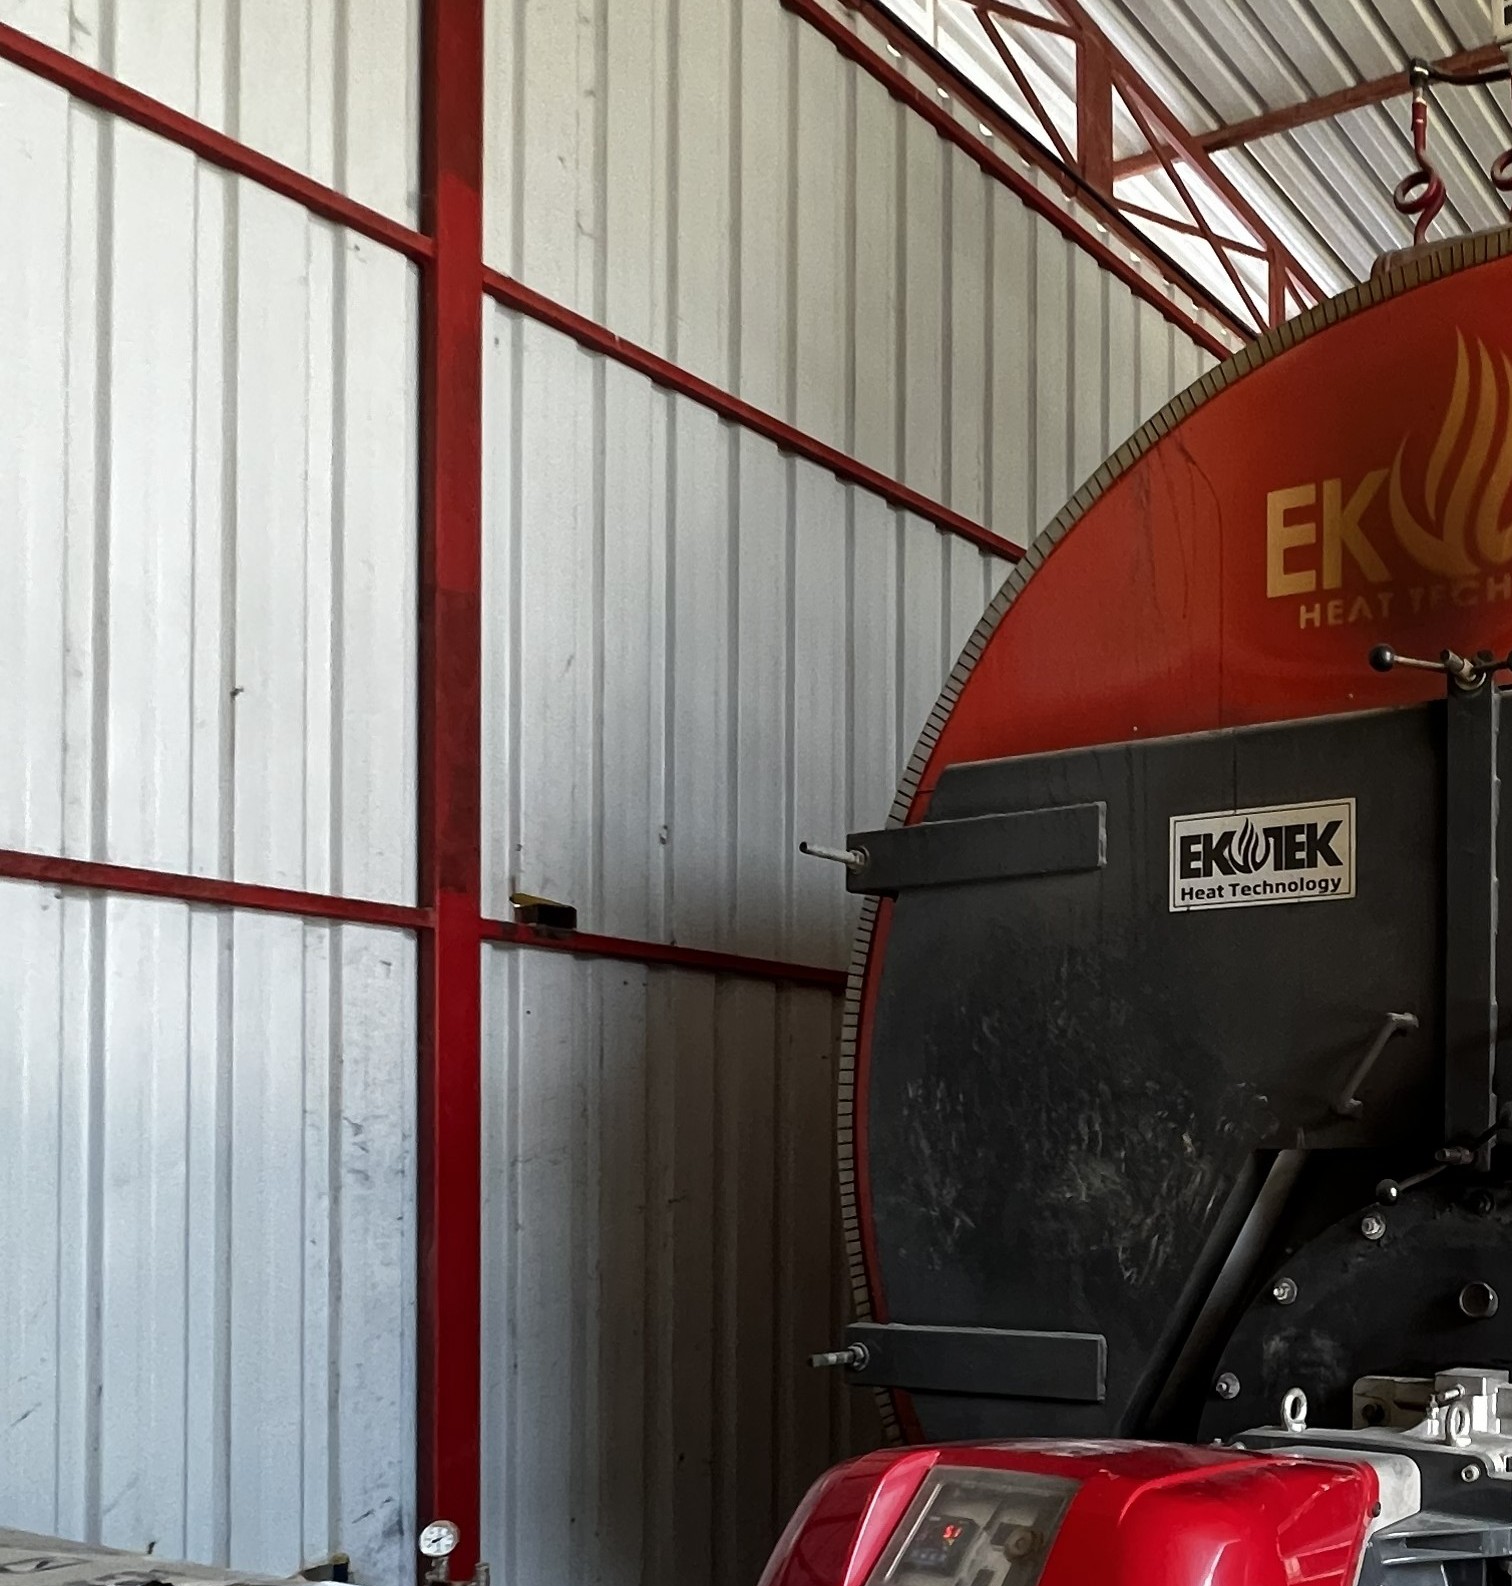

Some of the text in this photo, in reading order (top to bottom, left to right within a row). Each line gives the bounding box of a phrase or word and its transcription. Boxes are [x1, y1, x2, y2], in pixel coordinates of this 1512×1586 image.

[1299, 592, 1395, 630] HEAT
[1181, 877, 1342, 901] Heat Technology
